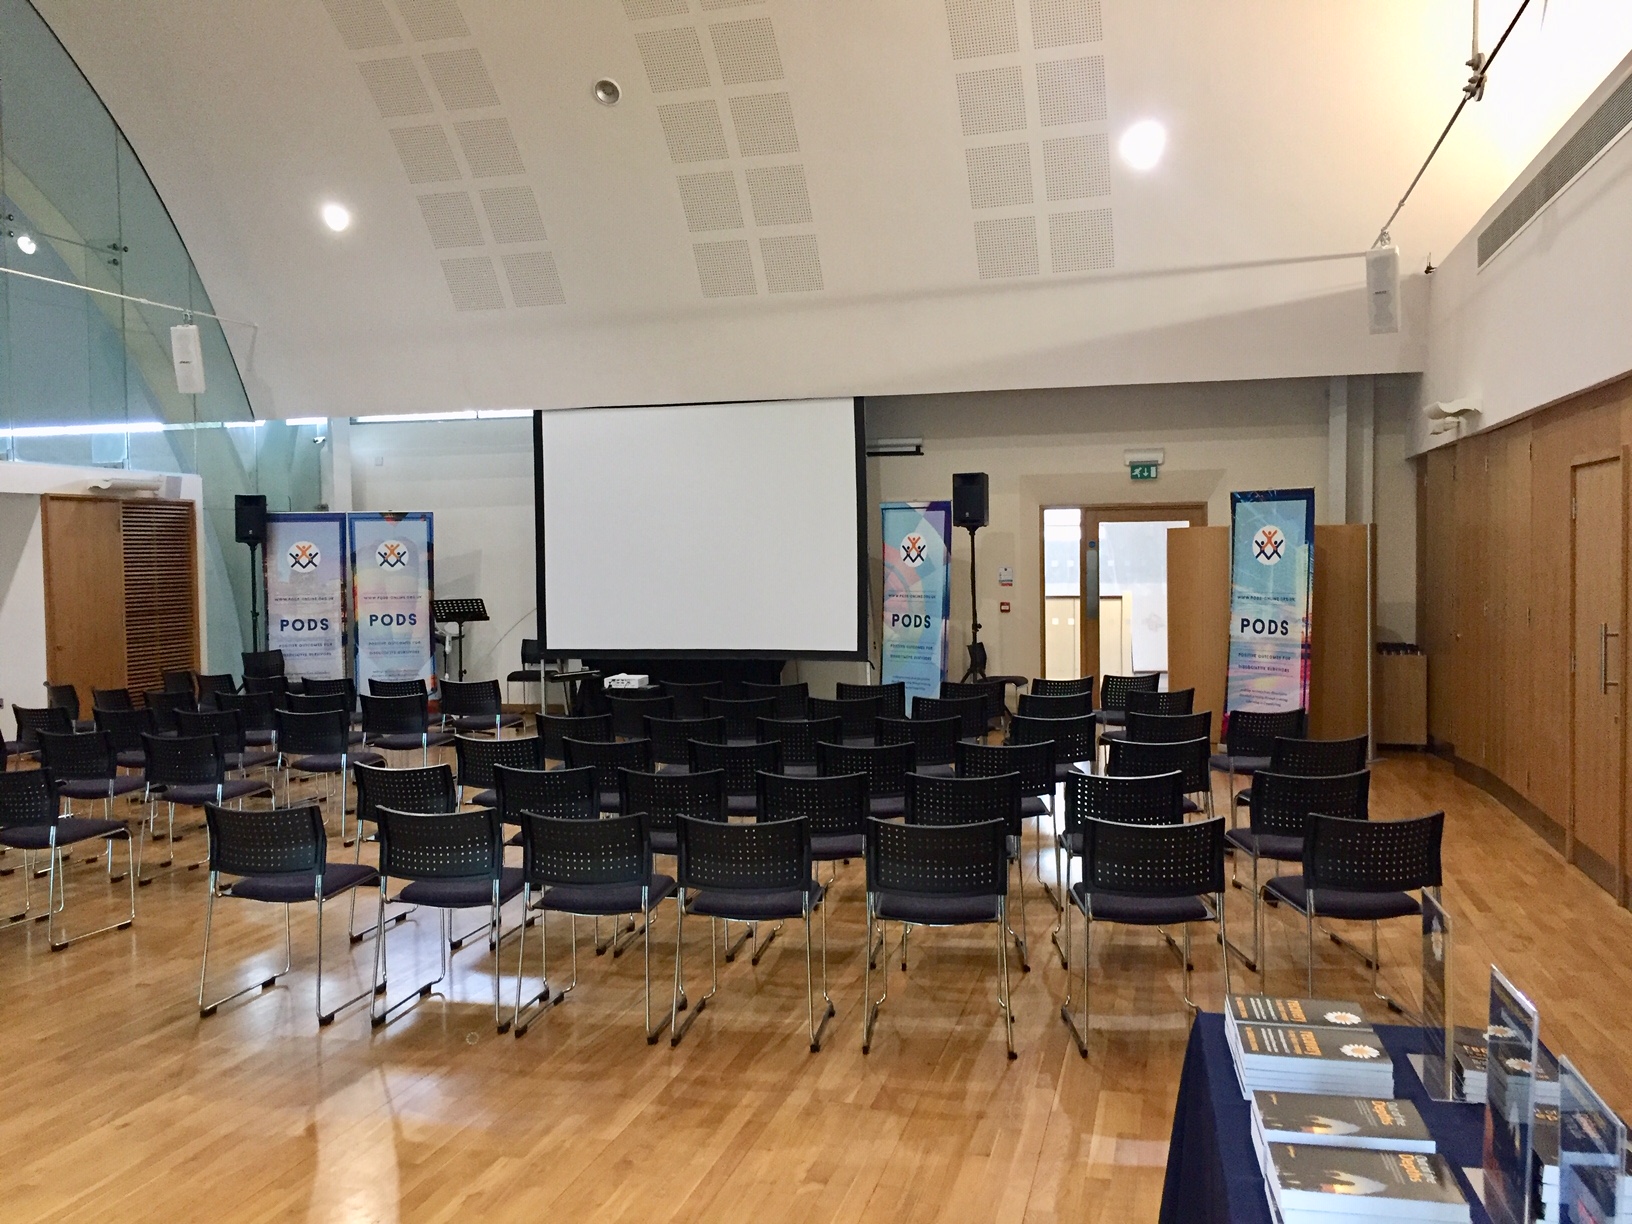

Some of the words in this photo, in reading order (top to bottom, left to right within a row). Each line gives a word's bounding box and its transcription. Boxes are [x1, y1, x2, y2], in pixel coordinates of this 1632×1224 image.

[280, 618, 330, 632] PODS
[369, 613, 418, 627] PODS
[892, 614, 931, 629] PODS
[1240, 618, 1289, 636] PODS
[1398, 1154, 1423, 1183] Depths
